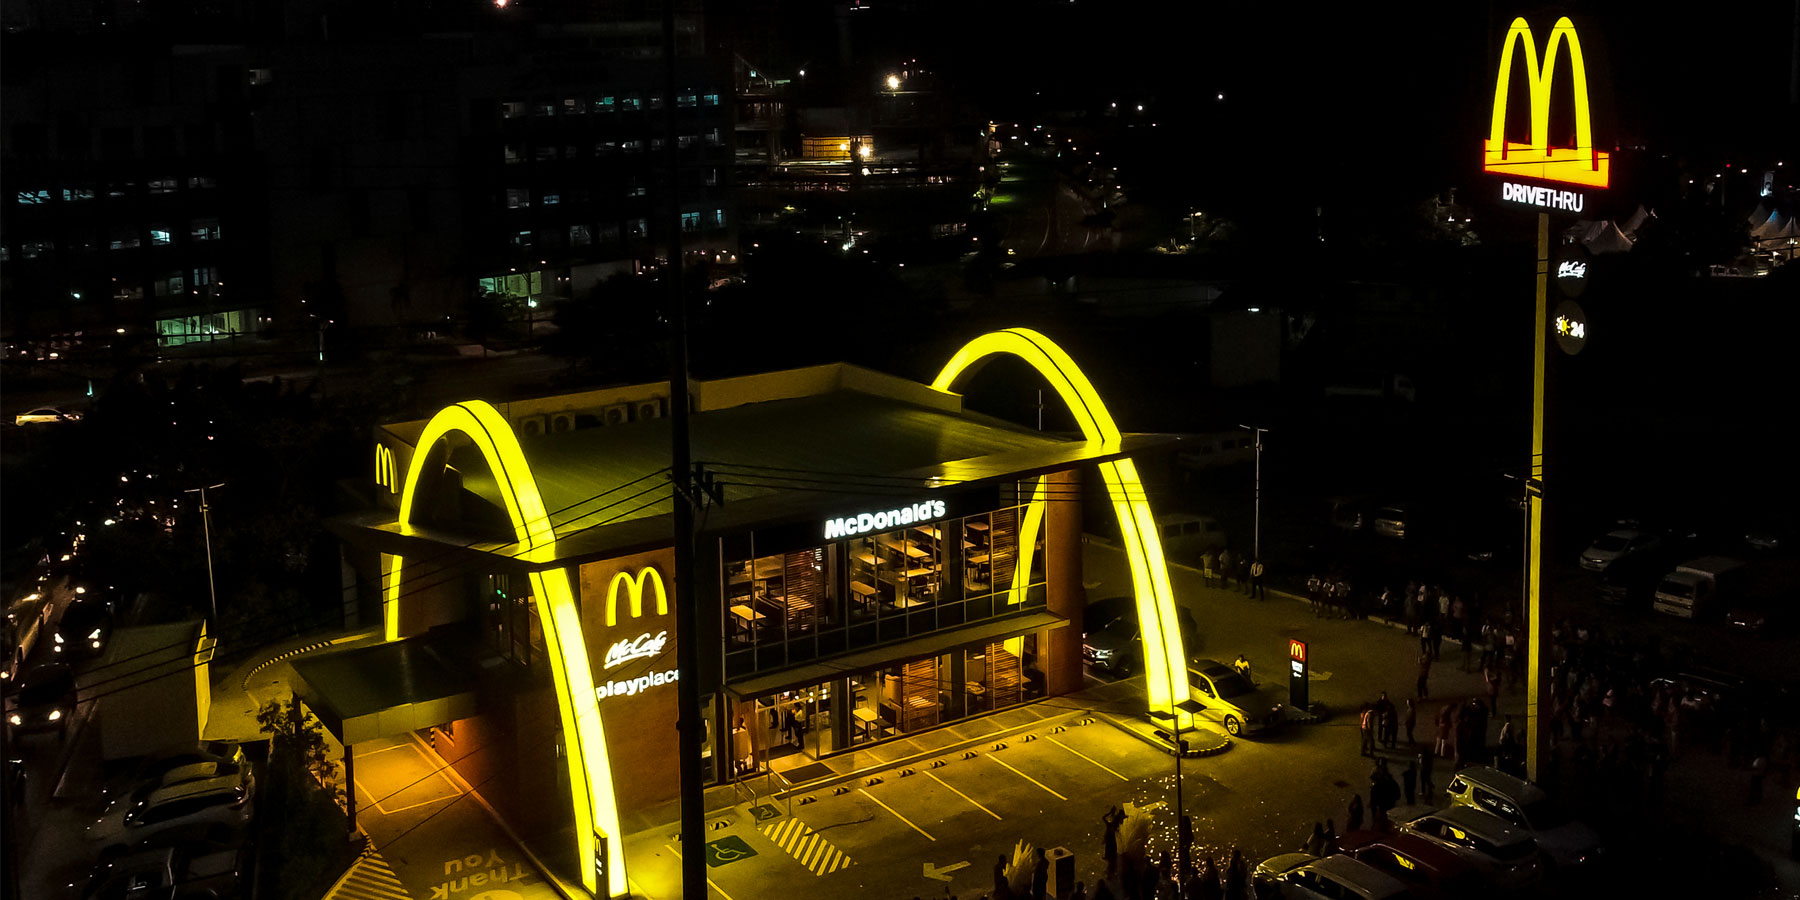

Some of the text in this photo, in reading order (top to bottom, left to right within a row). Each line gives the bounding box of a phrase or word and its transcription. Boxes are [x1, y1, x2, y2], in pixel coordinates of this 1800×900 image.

[1570, 321, 1585, 338] 24
[824, 500, 946, 540] McDonald's
[444, 848, 504, 876] You
